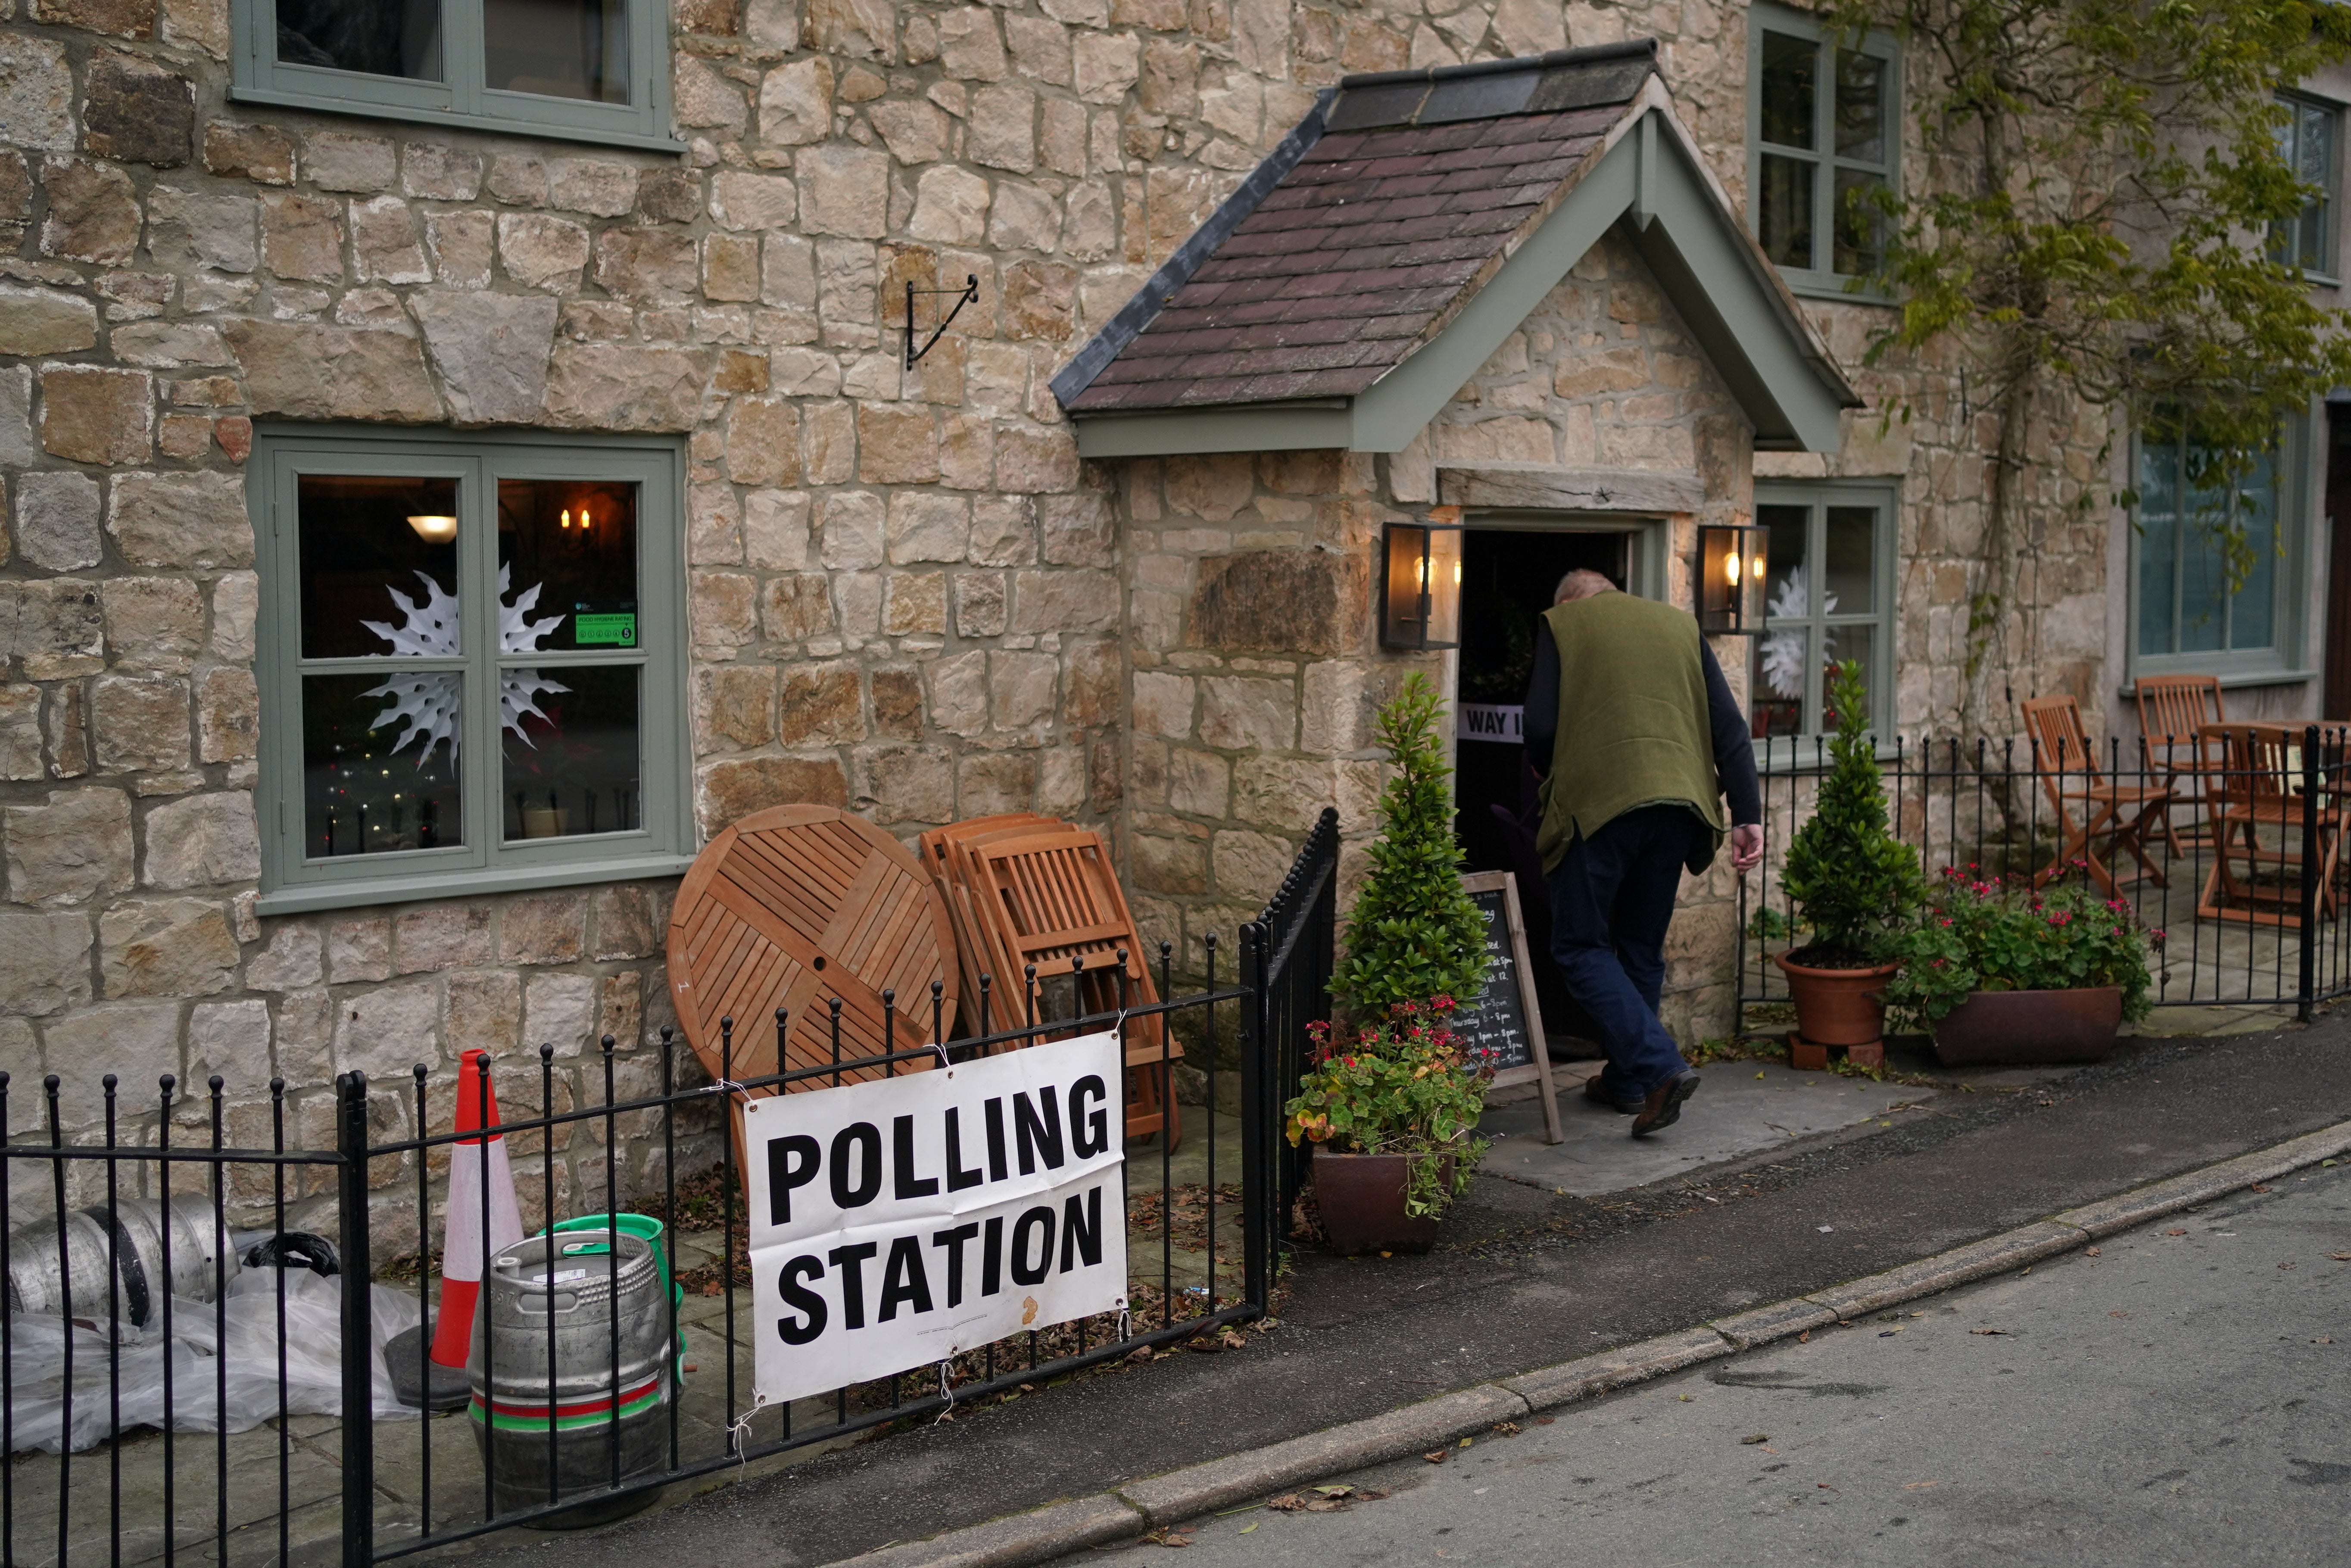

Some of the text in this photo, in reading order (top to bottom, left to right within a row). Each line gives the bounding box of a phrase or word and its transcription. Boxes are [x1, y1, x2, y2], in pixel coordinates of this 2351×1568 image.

[624, 629, 630, 638] 5
[1467, 710, 1524, 735] WAY I
[1487, 974, 1496, 983] at
[1449, 1018, 1479, 1029] Thursday
[1478, 1032, 1493, 1043] 1pm
[768, 1075, 1108, 1226] POLLING
[778, 1185, 1102, 1345] STATION
